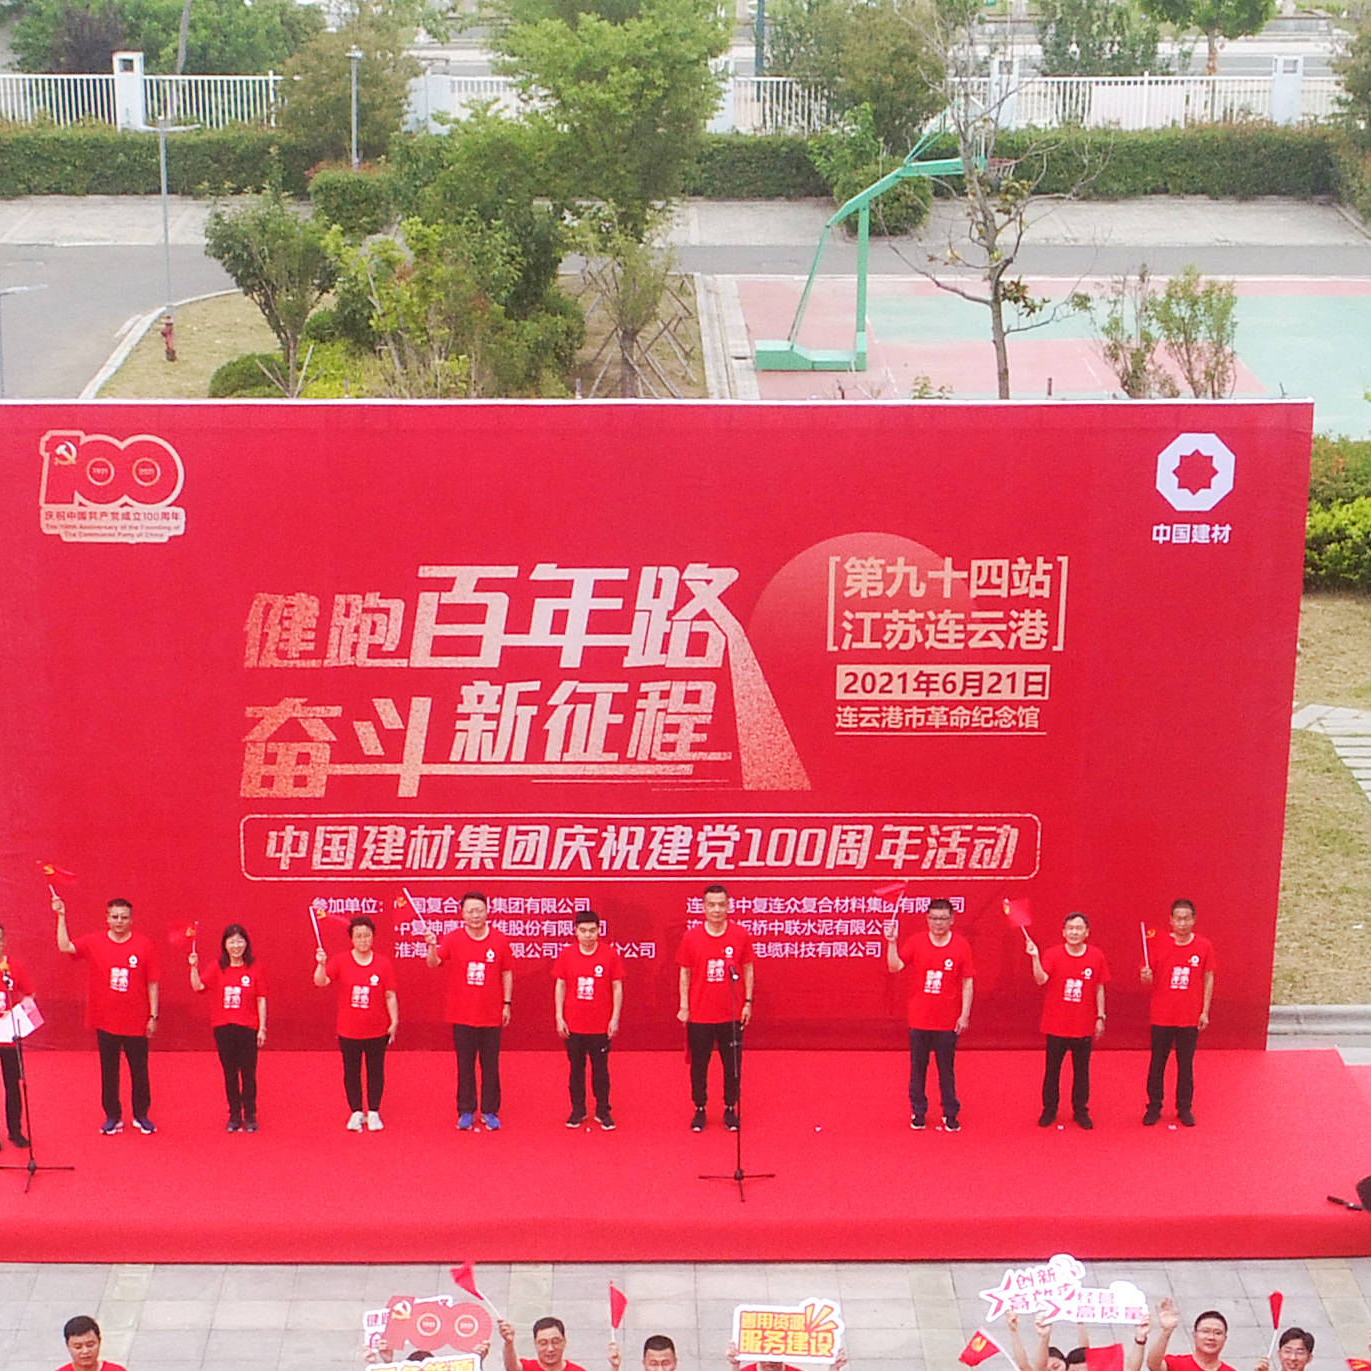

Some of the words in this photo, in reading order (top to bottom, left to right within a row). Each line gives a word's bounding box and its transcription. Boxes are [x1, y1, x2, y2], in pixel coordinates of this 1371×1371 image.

[1151, 523, 1232, 545] 中国建材
[842, 556, 1053, 600] 第九十四站
[243, 562, 740, 669] 健跑百年路
[841, 608, 1050, 651] 江苏连云港
[842, 669, 1049, 698] 2021年6月21日
[835, 705, 1041, 730] 连云港市革命纪念馆
[240, 680, 733, 798] 奋斗新征程
[265, 823, 1022, 872] 中国建材集团庆祝建党100周年活动
[393, 897, 591, 914] 国复合集团有限公司
[686, 897, 965, 914] 连中复连众复合材料集团有限司
[738, 1330, 835, 1357] 服务建设
